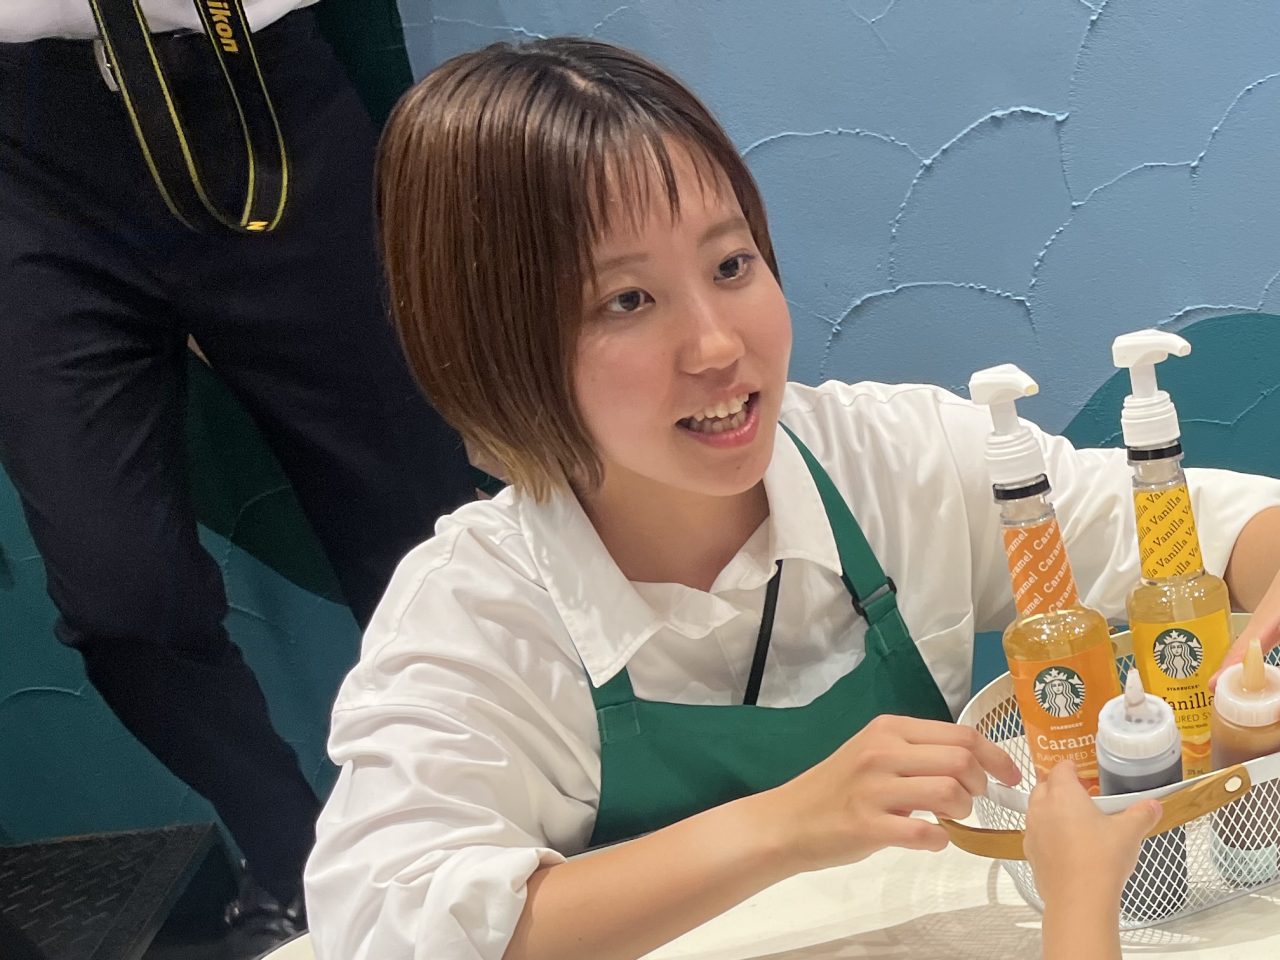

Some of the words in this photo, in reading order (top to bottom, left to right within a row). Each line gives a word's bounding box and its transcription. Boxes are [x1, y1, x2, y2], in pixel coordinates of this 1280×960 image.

[1149, 496, 1182, 526] Vanilla
[1153, 517, 1185, 547] Vanilla
[1156, 538, 1188, 568] Vanilla
[1050, 722, 1084, 731] STARBUCKS
